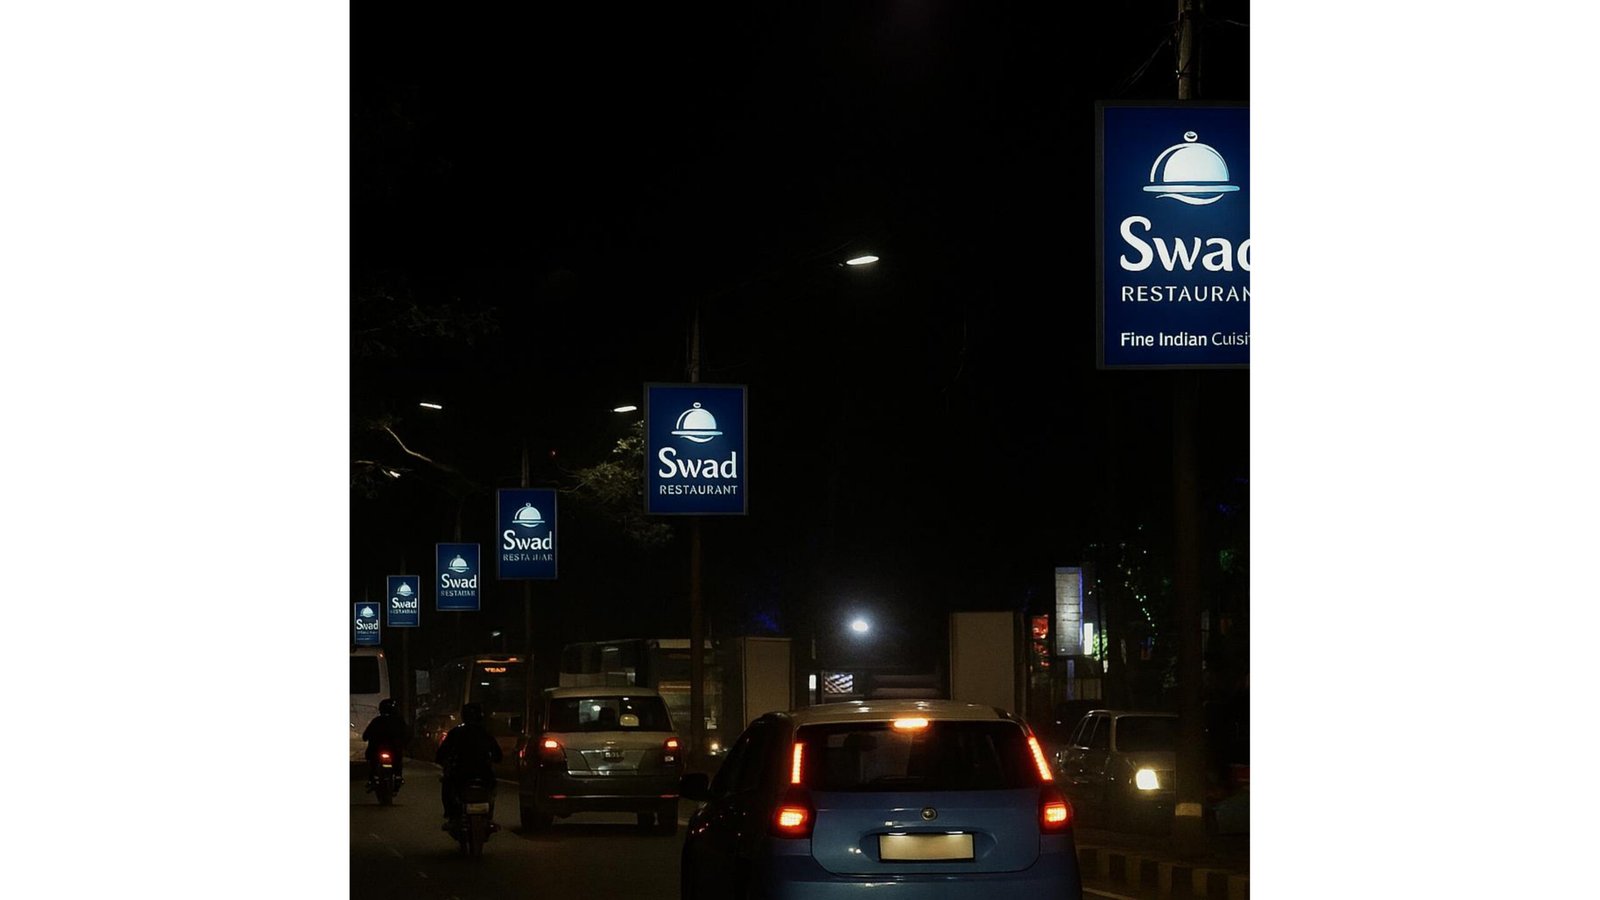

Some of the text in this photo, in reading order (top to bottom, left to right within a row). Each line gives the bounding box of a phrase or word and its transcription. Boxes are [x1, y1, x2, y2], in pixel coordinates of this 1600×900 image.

[1120, 331, 1250, 347] Fine Indian Cuisi
[658, 446, 737, 479] Swad
[659, 484, 738, 495] RESTAURANT
[503, 529, 553, 550] Swad
[441, 573, 477, 589] Swad
[391, 597, 417, 609] Swad
[356, 618, 379, 630] Swad
